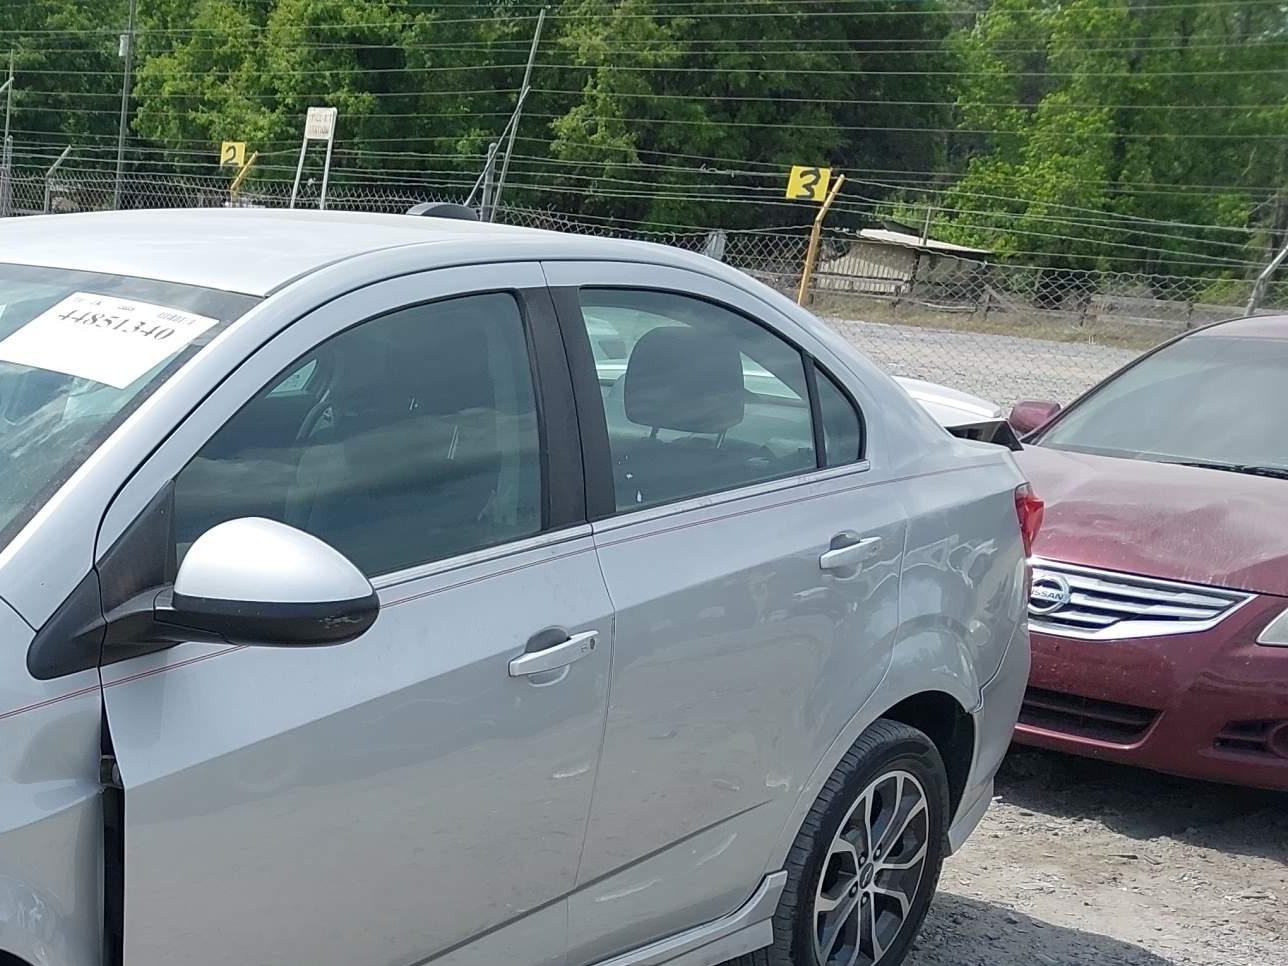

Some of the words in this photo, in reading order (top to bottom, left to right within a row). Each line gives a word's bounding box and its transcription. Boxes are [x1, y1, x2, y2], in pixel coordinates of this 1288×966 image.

[223, 145, 239, 165] 2
[58, 309, 176, 340] 44851340
[1031, 589, 1064, 601] ISSAN
